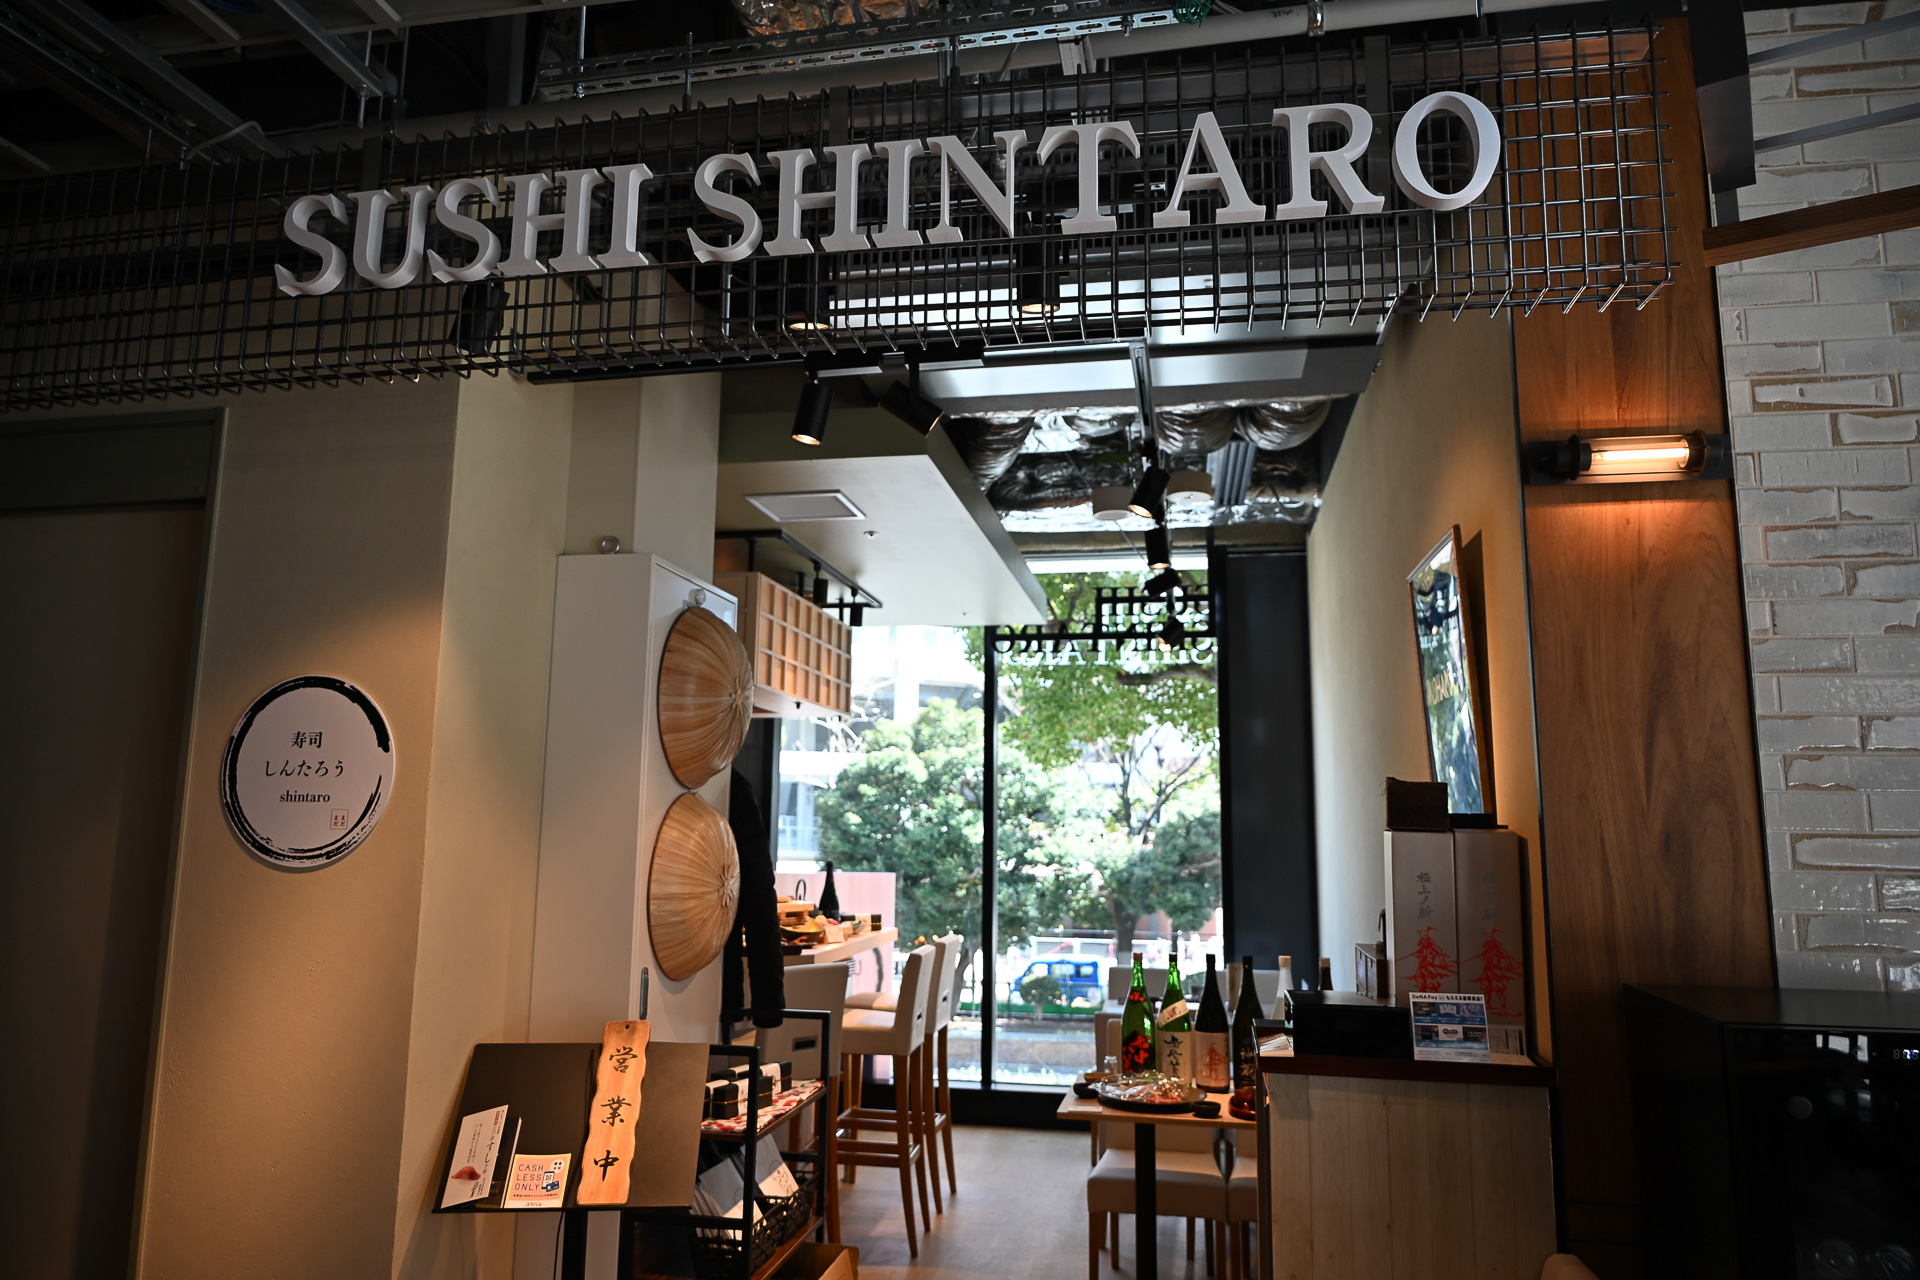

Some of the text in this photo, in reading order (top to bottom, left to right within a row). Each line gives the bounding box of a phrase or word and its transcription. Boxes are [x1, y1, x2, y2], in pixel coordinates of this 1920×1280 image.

[274, 91, 1501, 297] SUSHI SHINTARO
[291, 731, 323, 749] 寿司
[265, 759, 344, 777] しんたろう
[279, 790, 330, 802] shintaro
[594, 1046, 638, 1182] 営業中
[518, 1163, 544, 1172] CASH
[516, 1173, 542, 1182] LESS
[514, 1182, 540, 1191] ONLY
